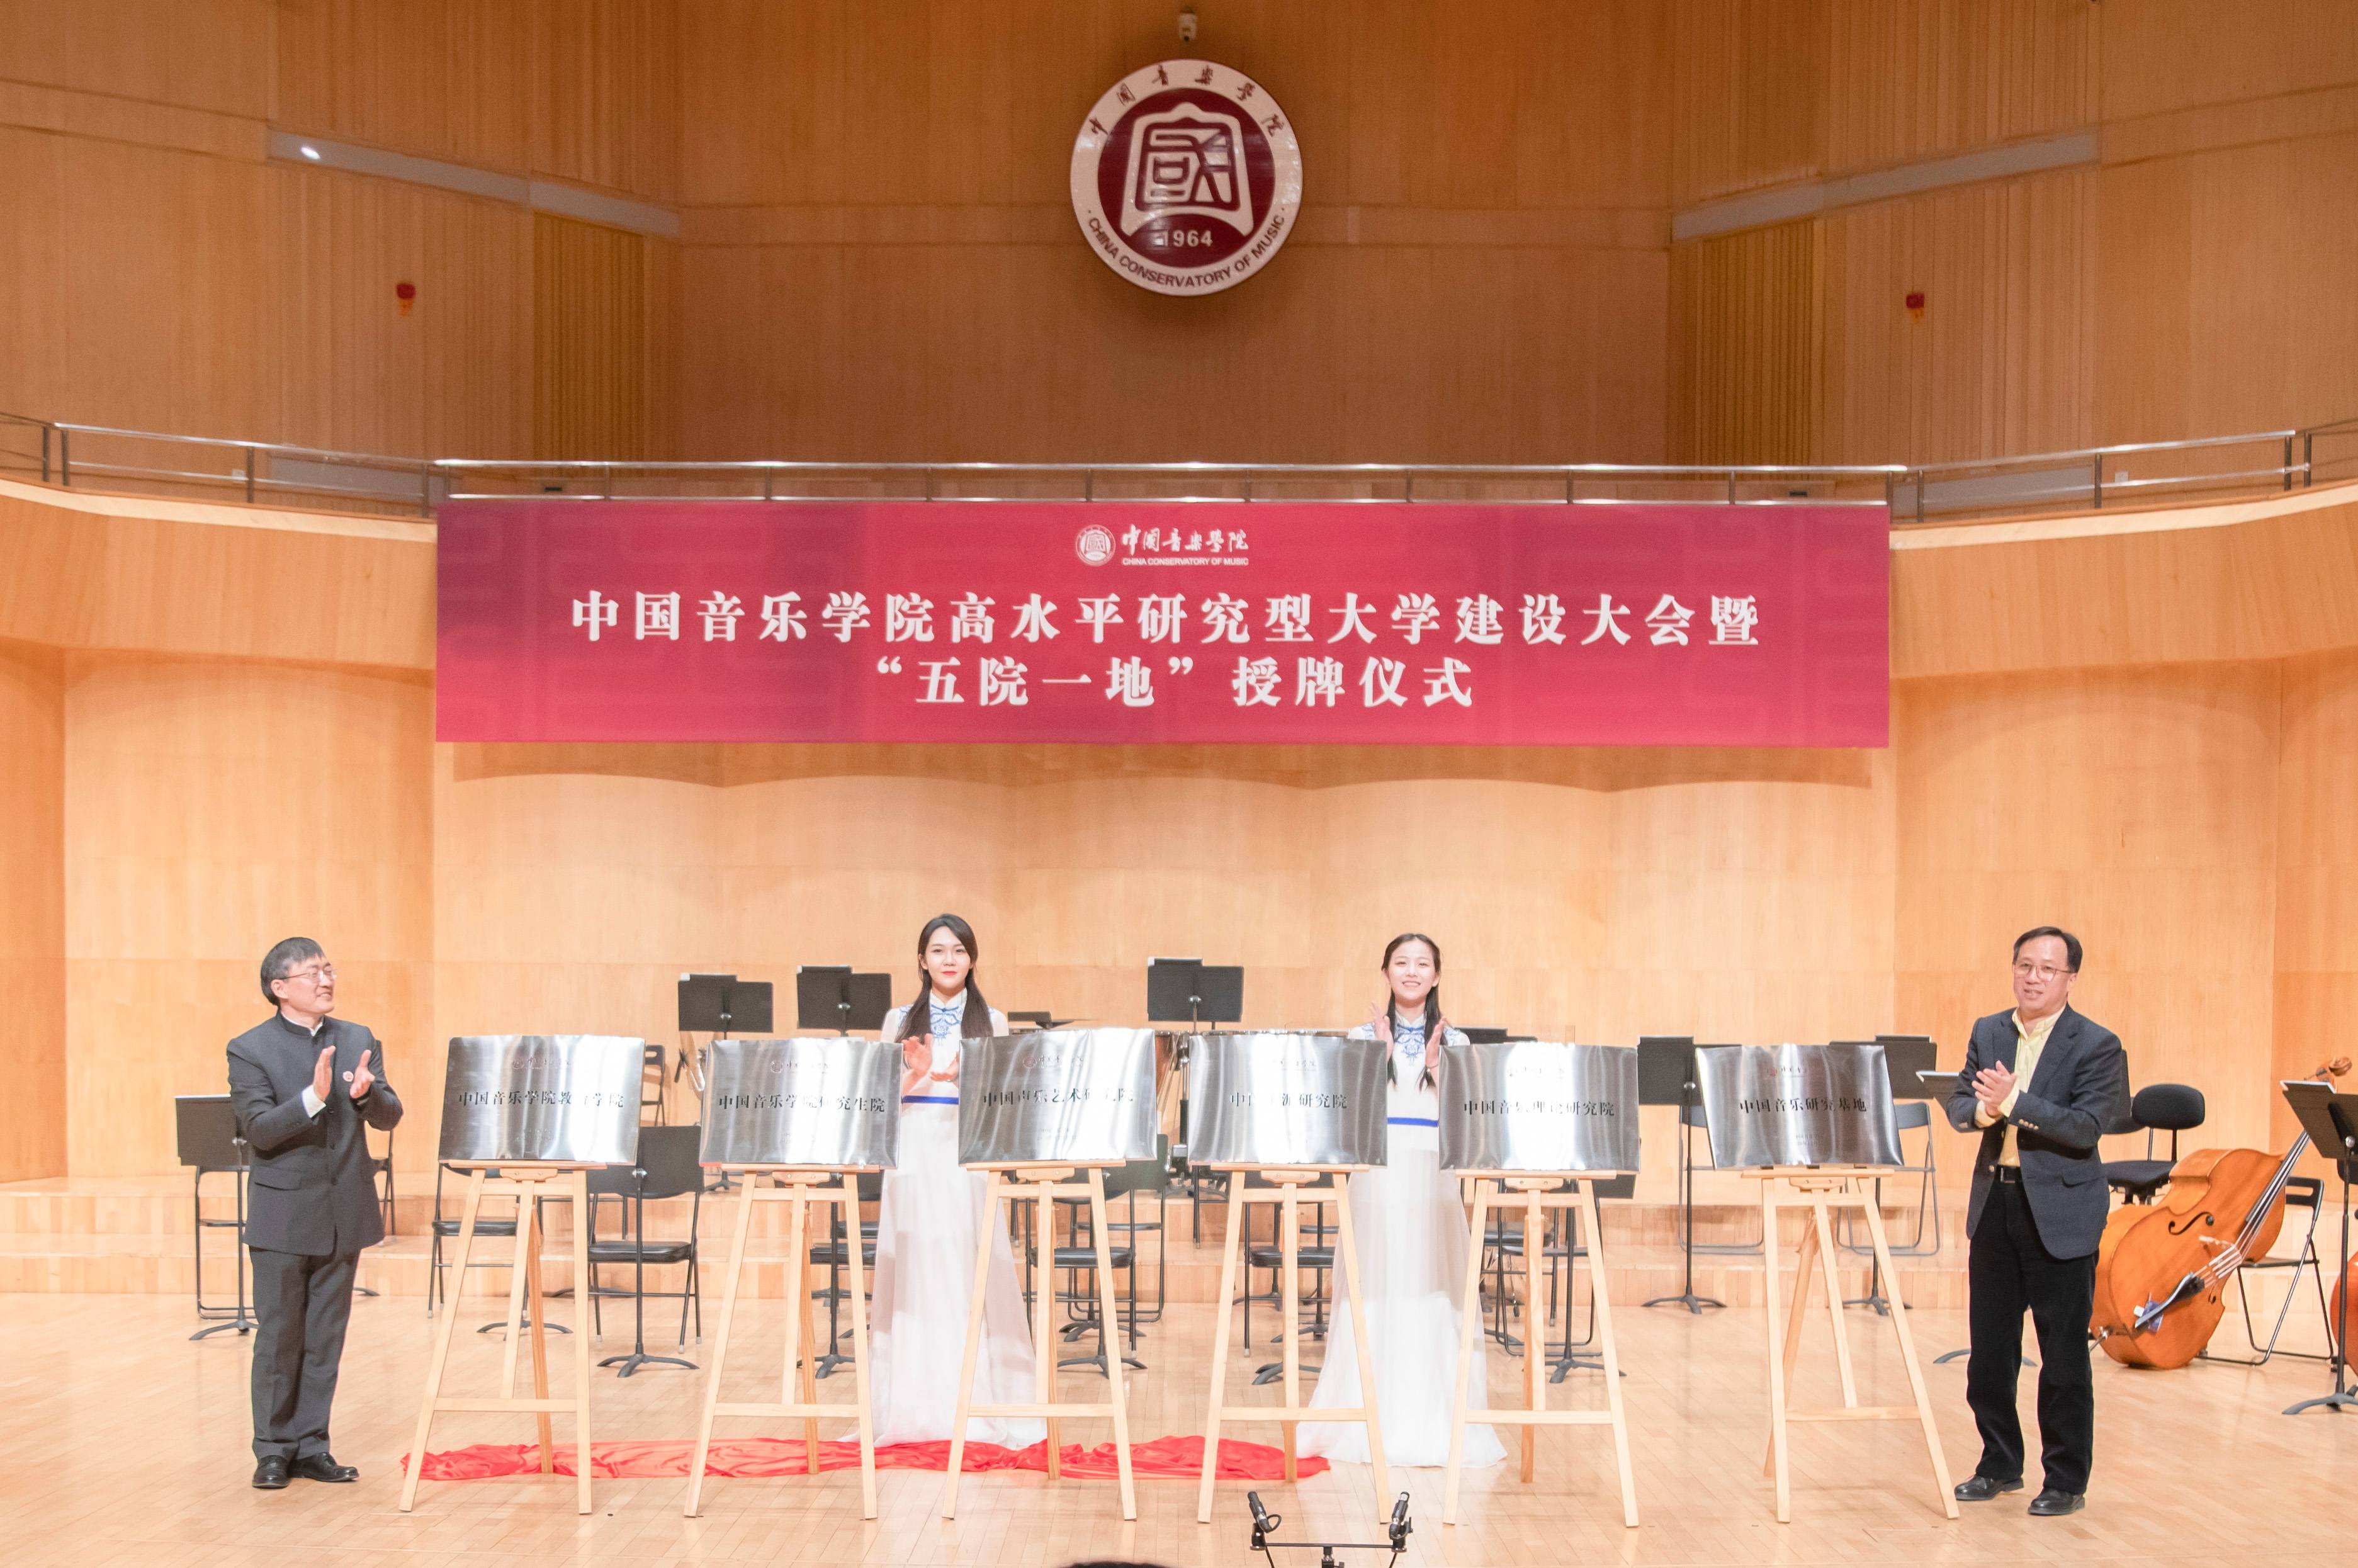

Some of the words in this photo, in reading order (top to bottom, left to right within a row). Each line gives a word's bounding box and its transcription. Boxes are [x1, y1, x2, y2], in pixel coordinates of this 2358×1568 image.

[1163, 230, 1214, 247] 1964
[1088, 217, 1120, 259] CHINA
[1119, 254, 1231, 288] CONSERVATORY
[1234, 254, 1252, 272] OF
[1251, 215, 1285, 259] MUSIC
[1122, 557, 1146, 565] CHINA
[1148, 557, 1210, 565] CONSERVATORY
[1211, 557, 1222, 565] OF
[1224, 557, 1249, 565] MUSIC
[572, 590, 1759, 646] 中国音乐学院高水平研究型大学建设大会暨
[459, 1090, 624, 1108] 中国音乐学院教学院
